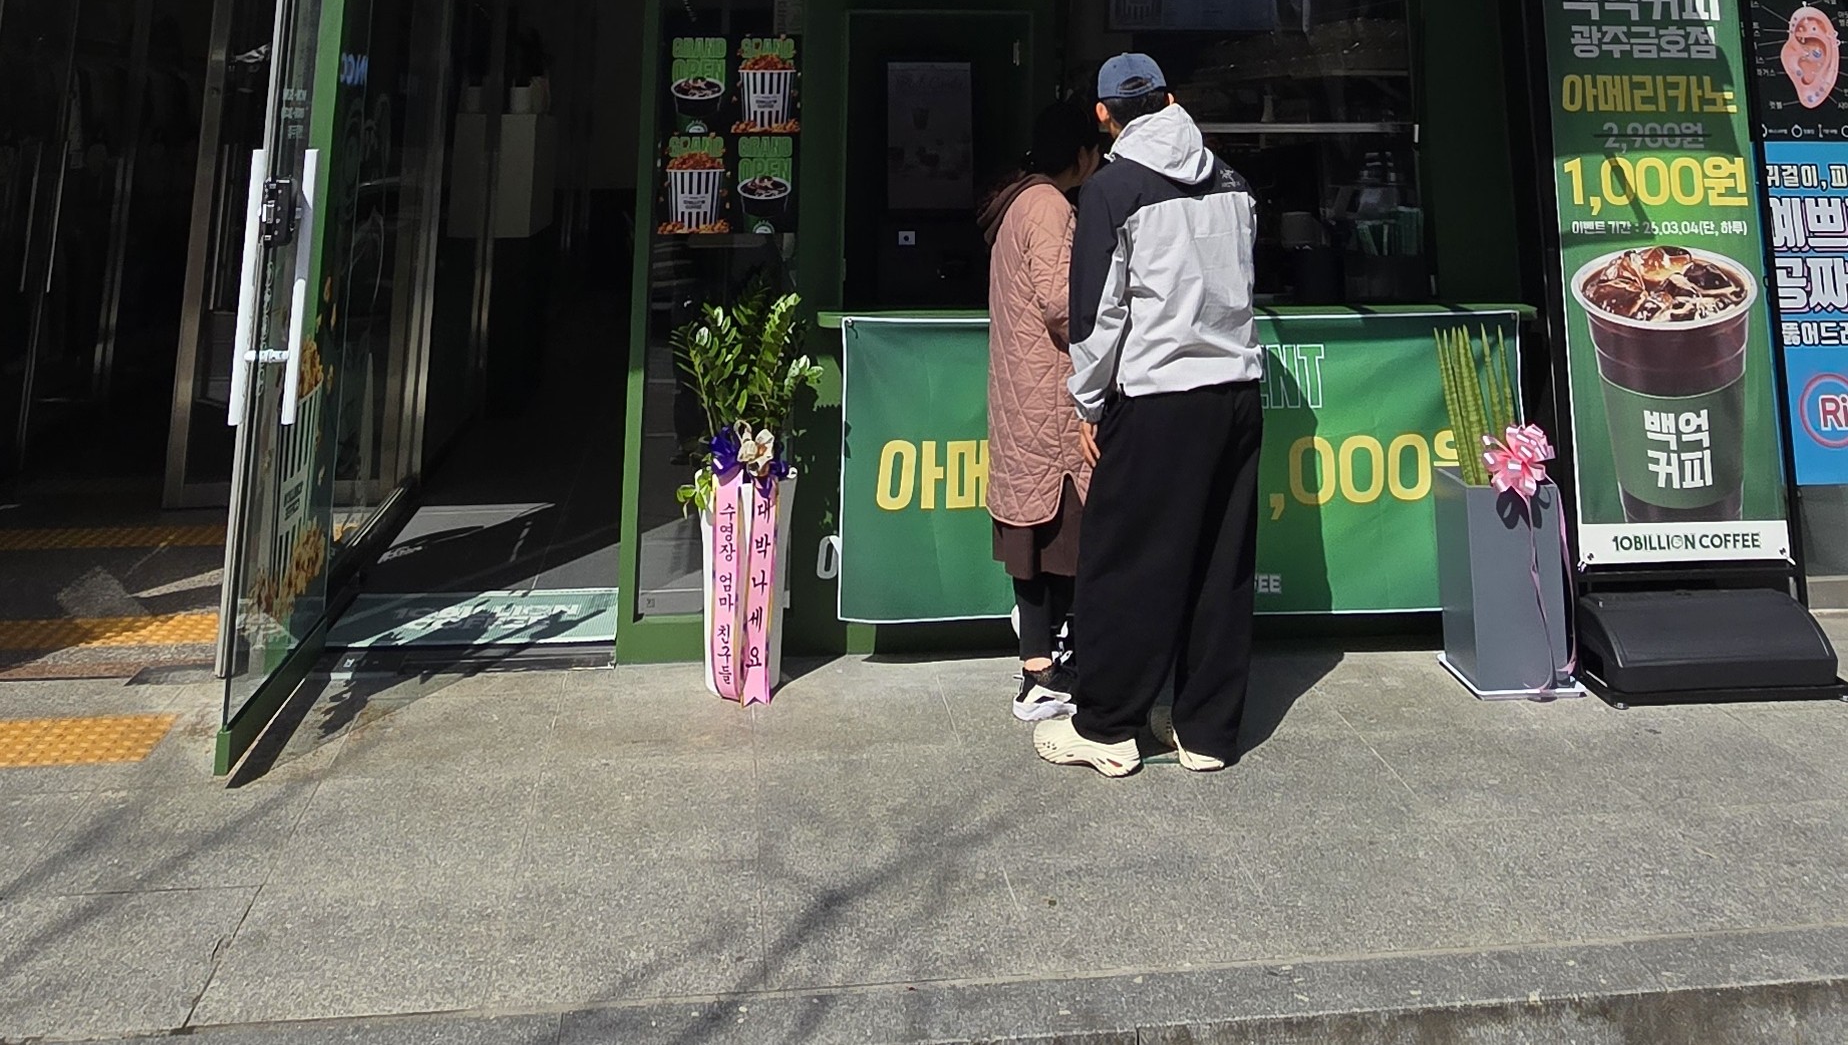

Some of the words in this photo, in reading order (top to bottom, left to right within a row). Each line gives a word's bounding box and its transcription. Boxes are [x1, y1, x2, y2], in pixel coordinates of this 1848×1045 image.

[1571, 25, 1717, 59] 광주금호점
[1562, 74, 1738, 113] 아메리카노
[1563, 157, 1749, 216] 1,000원
[1571, 220, 1606, 234] 이벤트
[1608, 220, 1632, 234] 기간
[1643, 409, 1710, 450] 백억
[1647, 449, 1713, 489] 커피
[1699, 532, 1761, 549] COFFEE
[718, 572, 735, 613] 엄마
